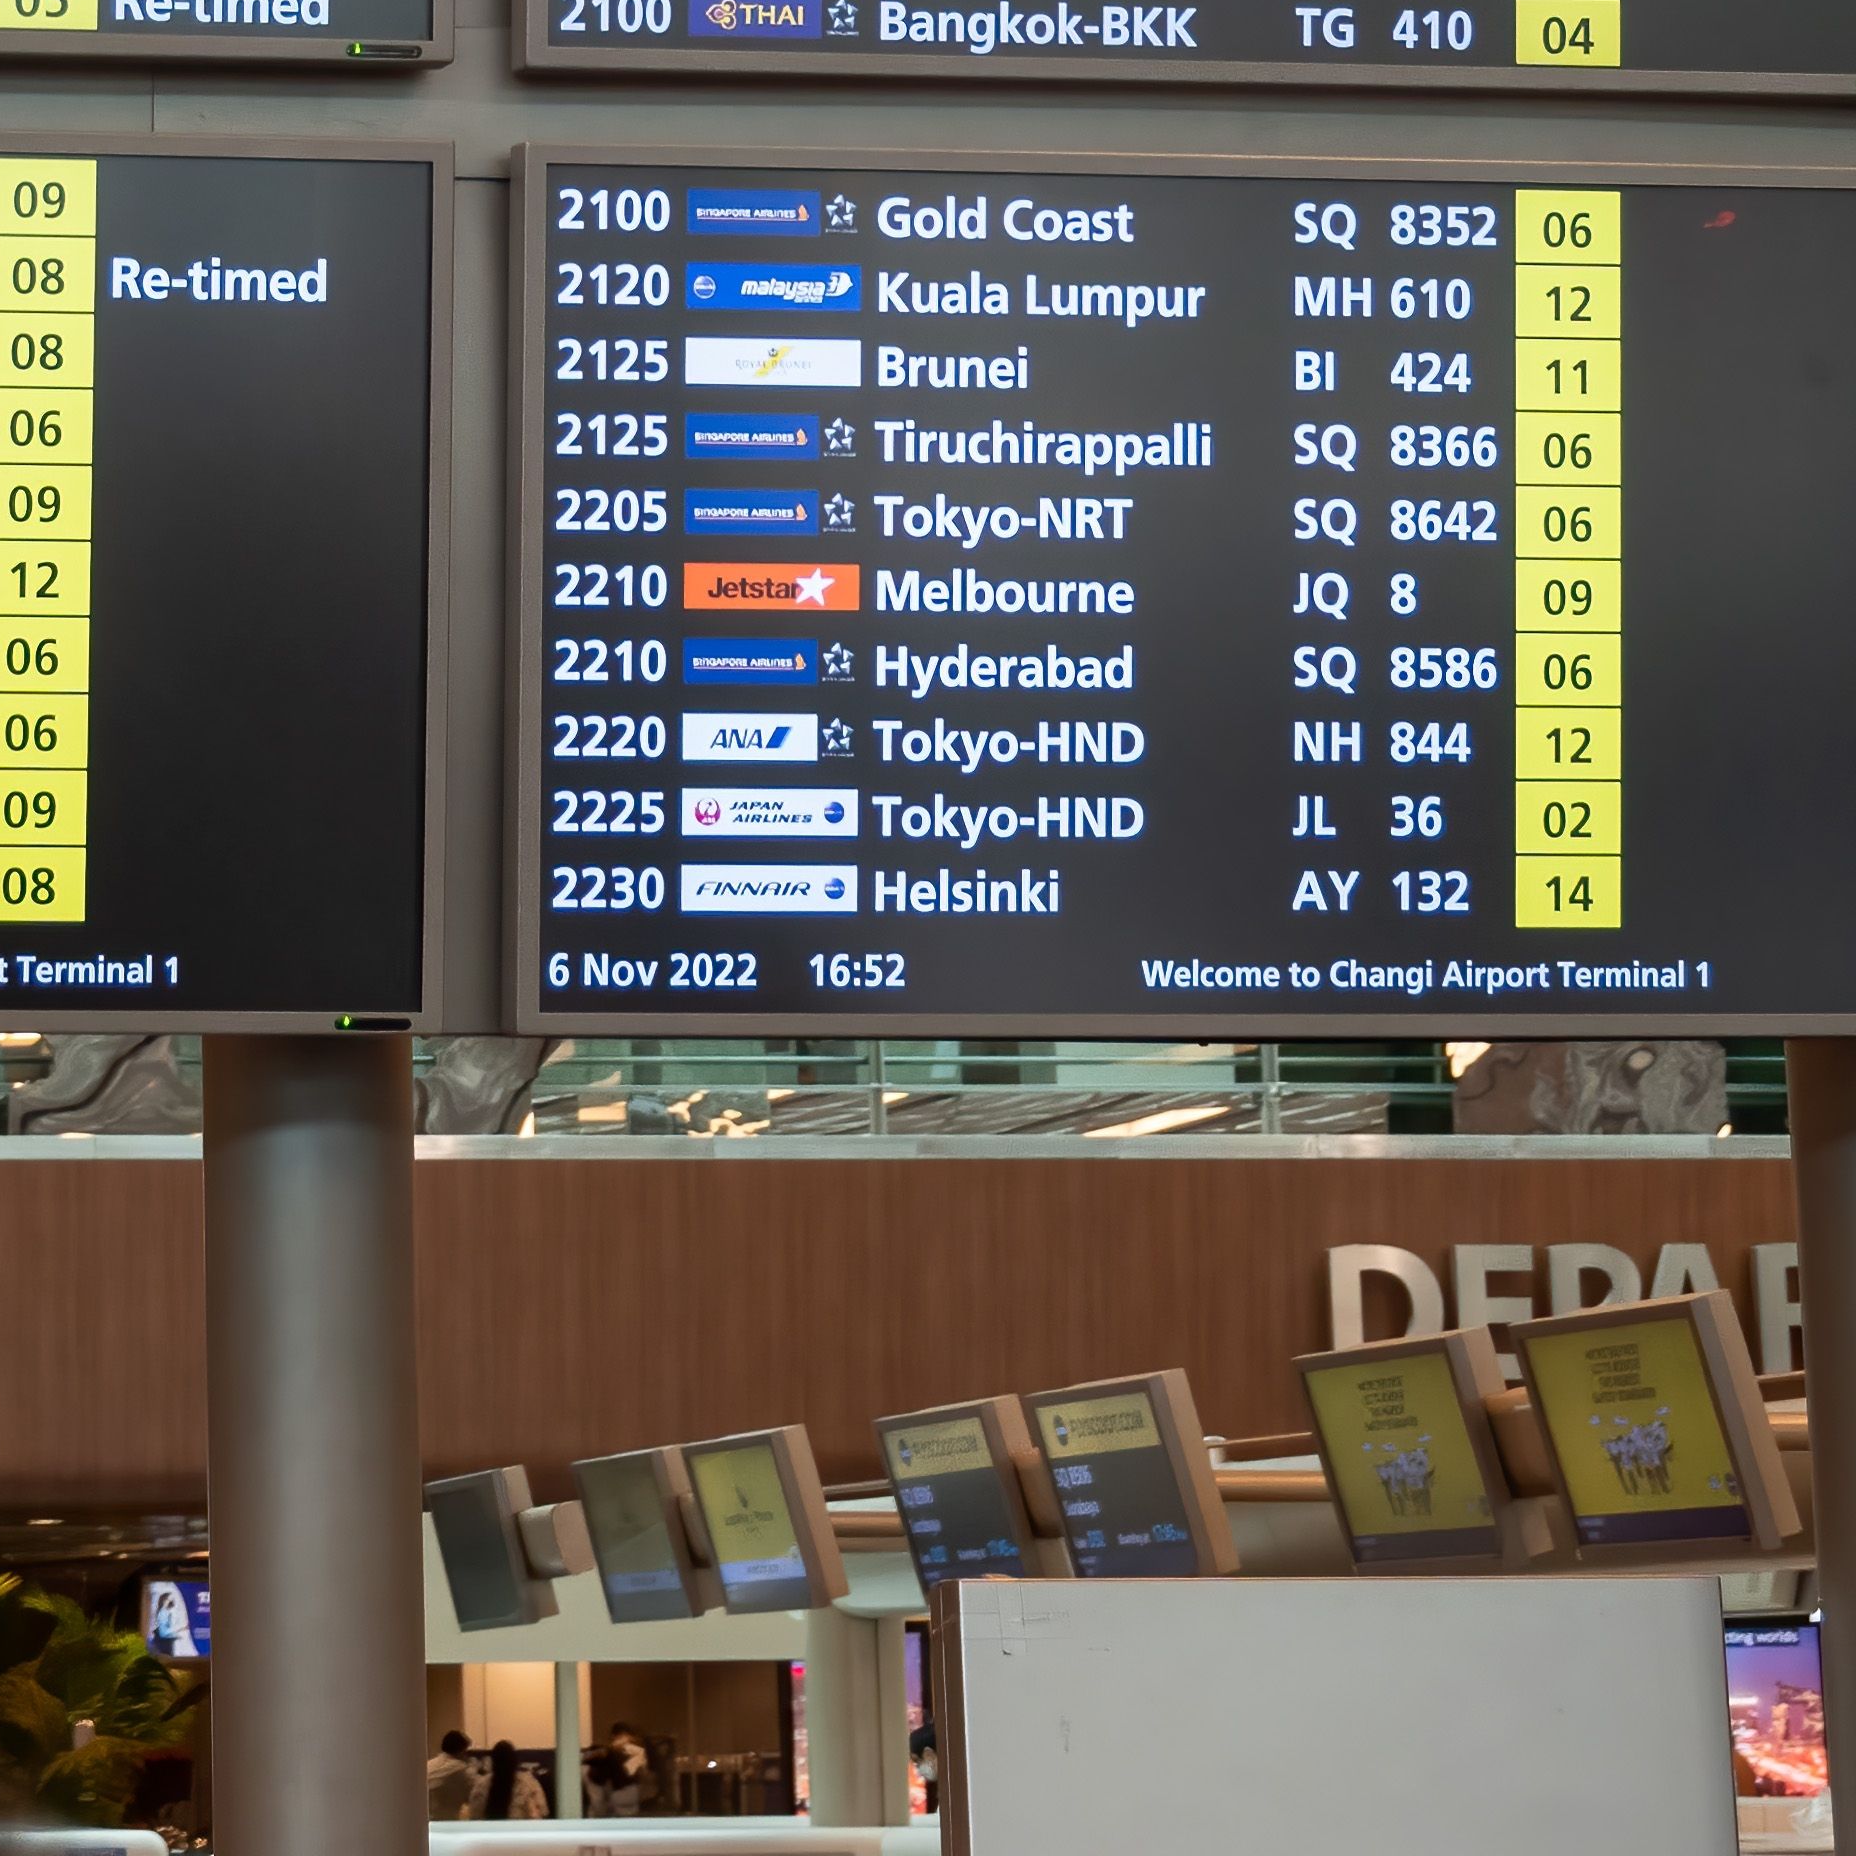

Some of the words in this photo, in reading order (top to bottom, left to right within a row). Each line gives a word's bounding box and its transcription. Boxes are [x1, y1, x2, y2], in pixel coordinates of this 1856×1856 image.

[740, 4, 805, 26] THAI
[880, 1, 1197, 54] Bangkok-BKK
[1296, 8, 1353, 47] TG
[1393, 10, 1471, 50] 410
[1543, 17, 1594, 54] 04
[13, 258, 64, 294] 08
[113, 257, 327, 302] Re-timed
[9, 486, 60, 522] 09
[554, 716, 665, 757] 2220
[710, 729, 764, 749] ANA
[873, 718, 1144, 773] Tokyo-HND
[1295, 722, 1360, 761] NH
[1391, 722, 1470, 762] 844
[1547, 728, 1591, 763] 12
[553, 867, 664, 908] 2230
[696, 883, 812, 897] FINNAIR
[875, 869, 1058, 912] Helsinki
[1293, 871, 1359, 910] AY
[1393, 871, 1468, 911] 132
[1546, 876, 1593, 911] 14
[17, 955, 152, 983] Terminal
[166, 957, 177, 983] 1
[549, 953, 569, 986] 6
[584, 953, 658, 986] Nov
[670, 953, 756, 986] 2022
[810, 954, 905, 987] 16:52
